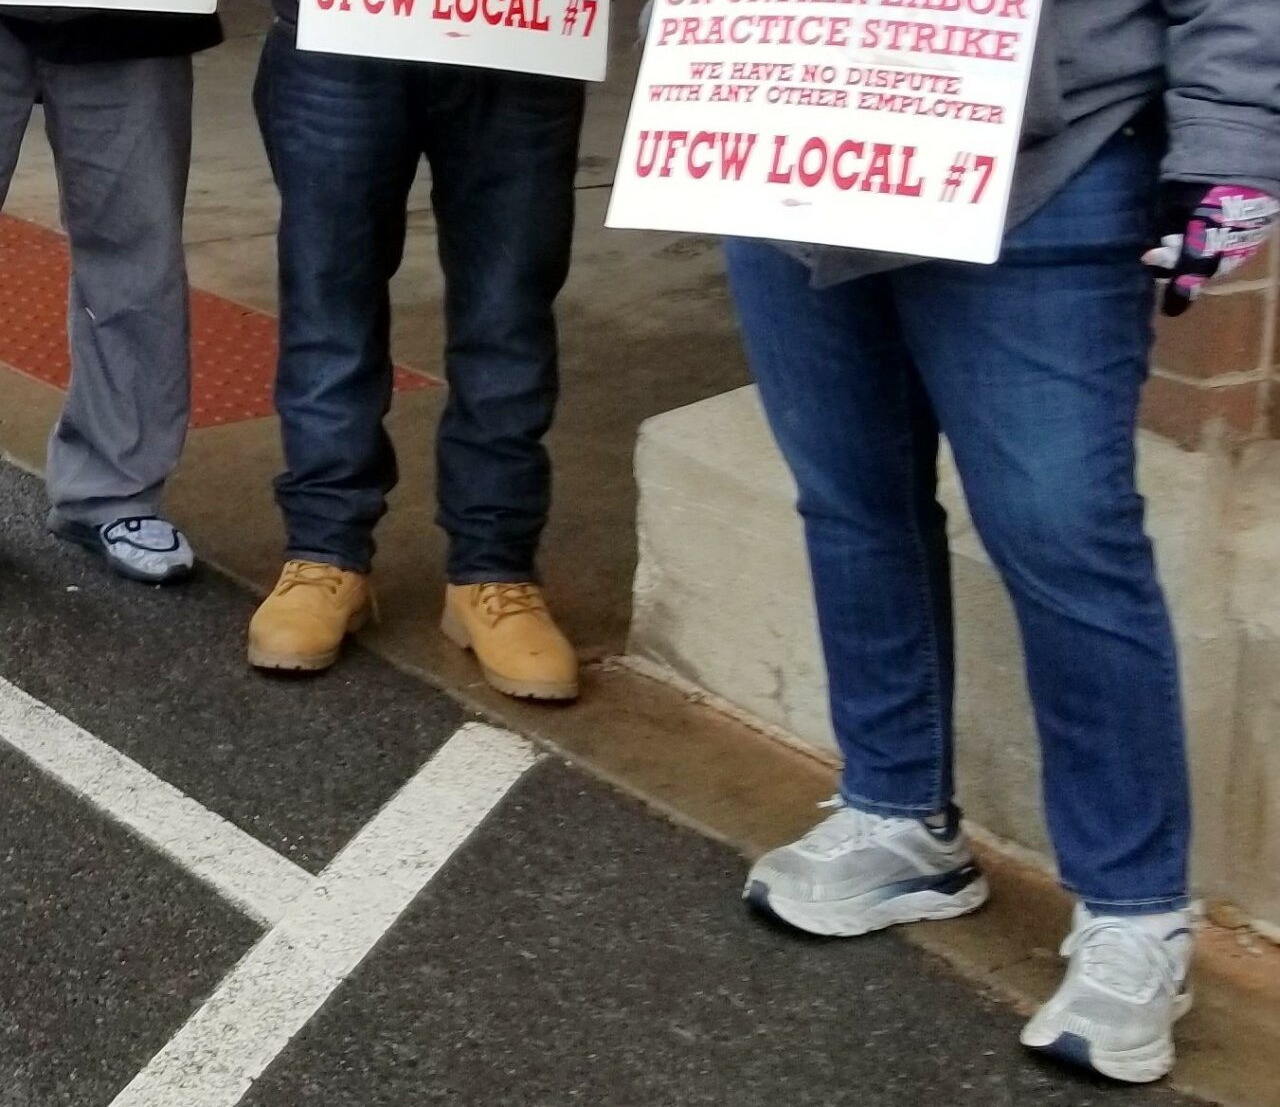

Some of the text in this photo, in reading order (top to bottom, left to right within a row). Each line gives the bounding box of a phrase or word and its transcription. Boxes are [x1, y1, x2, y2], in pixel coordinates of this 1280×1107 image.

[657, 16, 1019, 62] PRACTICE STRIKE
[689, 62, 962, 96] WE HAVE NO DISPUTE
[648, 83, 1005, 124] WITH ANY OTHER EMPLOYER
[634, 130, 997, 205] UFCW LOCAL #7
